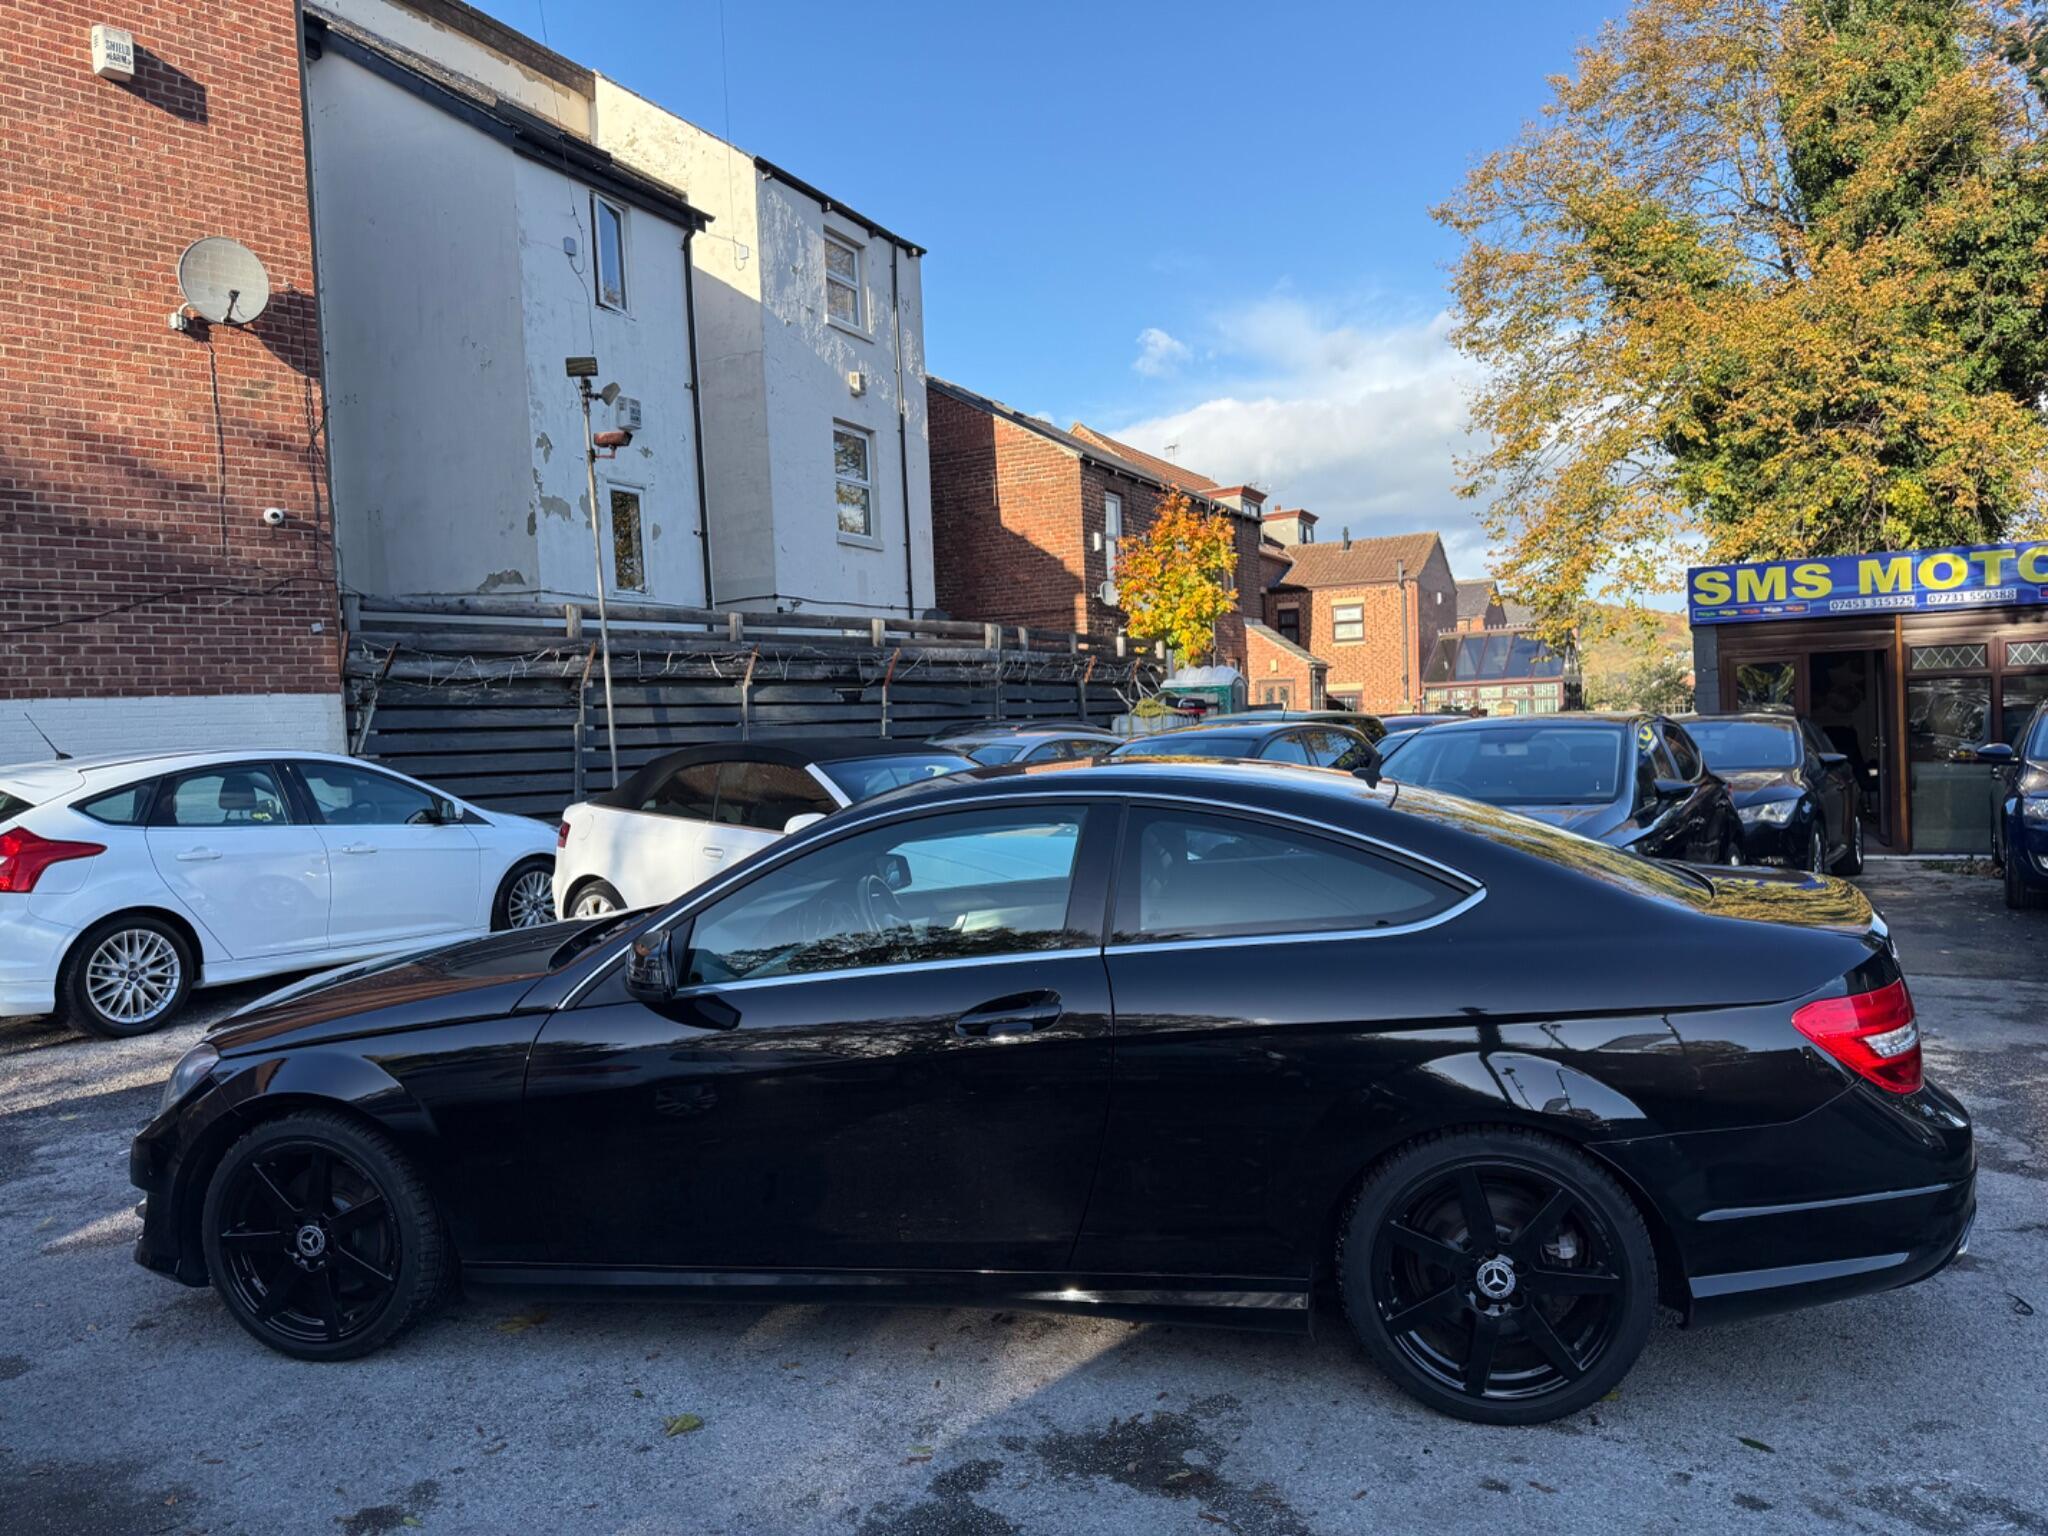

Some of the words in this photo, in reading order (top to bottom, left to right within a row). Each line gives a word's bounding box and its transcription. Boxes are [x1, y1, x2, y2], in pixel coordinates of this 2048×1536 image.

[105, 40, 131, 56] SHIELD
[1693, 562, 1833, 605] SMS
[1830, 599, 1867, 610] 07453
[1928, 593, 1965, 603] 07731
